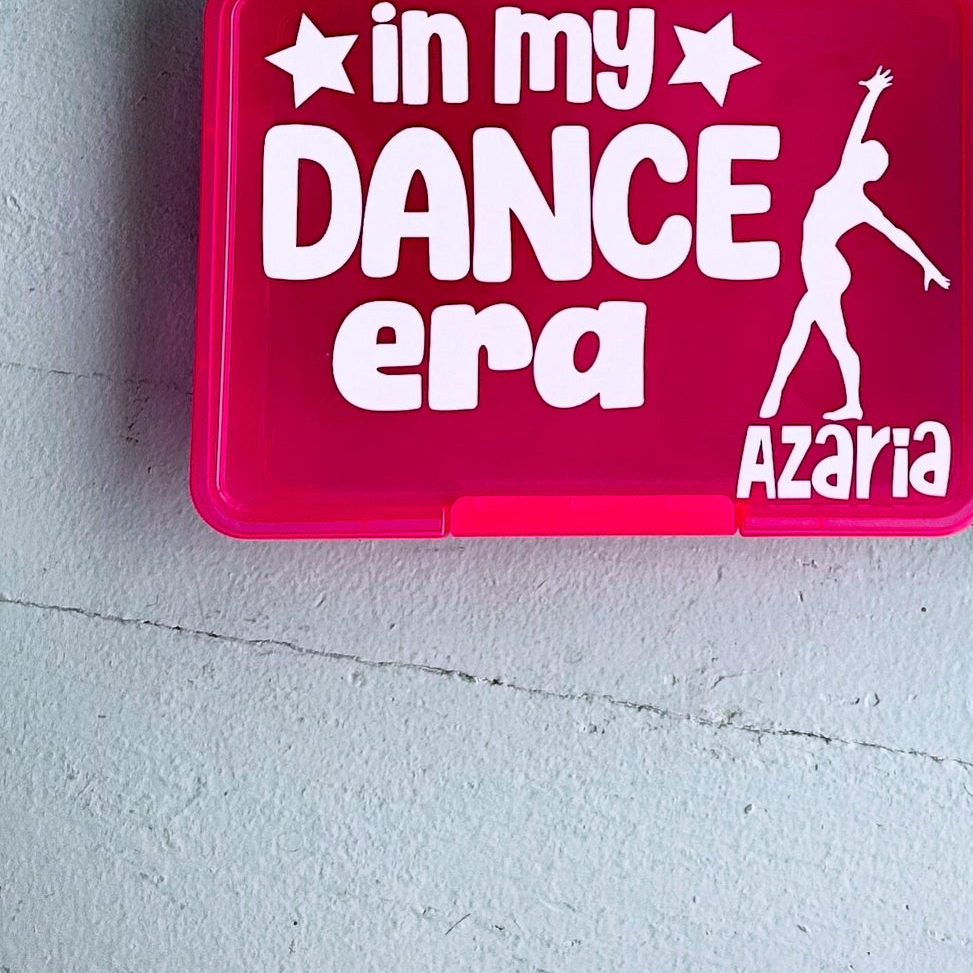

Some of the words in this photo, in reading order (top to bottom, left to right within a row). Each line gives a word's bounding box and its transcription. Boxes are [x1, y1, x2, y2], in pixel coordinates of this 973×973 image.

[372, 3, 468, 104] in
[495, 7, 654, 109] my
[263, 124, 780, 282] DANCE
[333, 301, 646, 410] era
